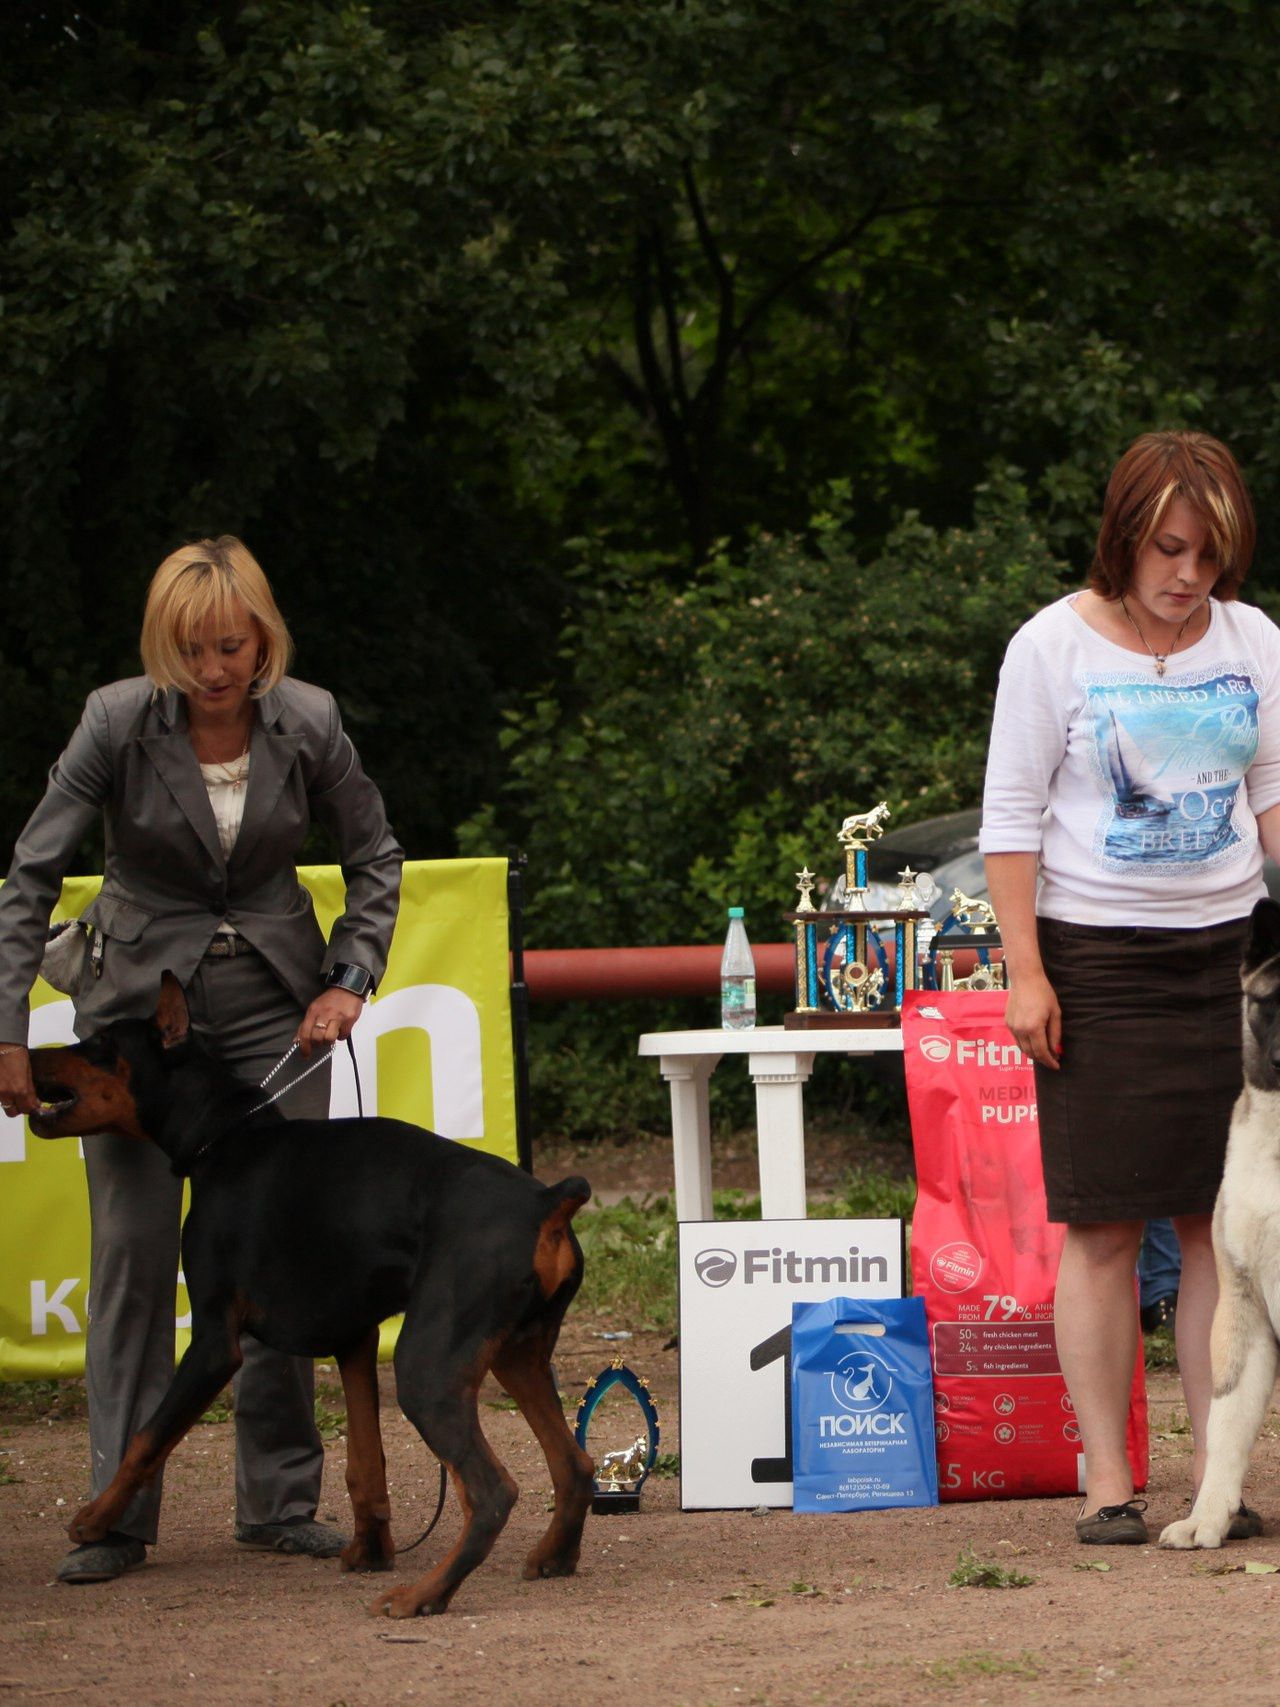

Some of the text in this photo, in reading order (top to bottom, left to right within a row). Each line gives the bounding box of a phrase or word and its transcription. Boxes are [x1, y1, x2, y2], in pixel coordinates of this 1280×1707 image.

[1089, 678, 1252, 707] ALL I NEED ARE
[743, 1246, 888, 1285] Fitmin
[945, 1261, 975, 1278] Fitmin
[958, 1304, 981, 1312] MADE
[958, 1313, 981, 1321] FROM
[1018, 1342, 1052, 1351] ingredients
[995, 1361, 1029, 1370] ingredients
[819, 1412, 906, 1437] ПОИСК
[819, 1439, 908, 1449] НЕЗАВИСИМАЯ ВЕТЕРИНАРНАЯ
[847, 1476, 881, 1484] labpoisk.ru
[972, 1470, 1006, 1489] KG
